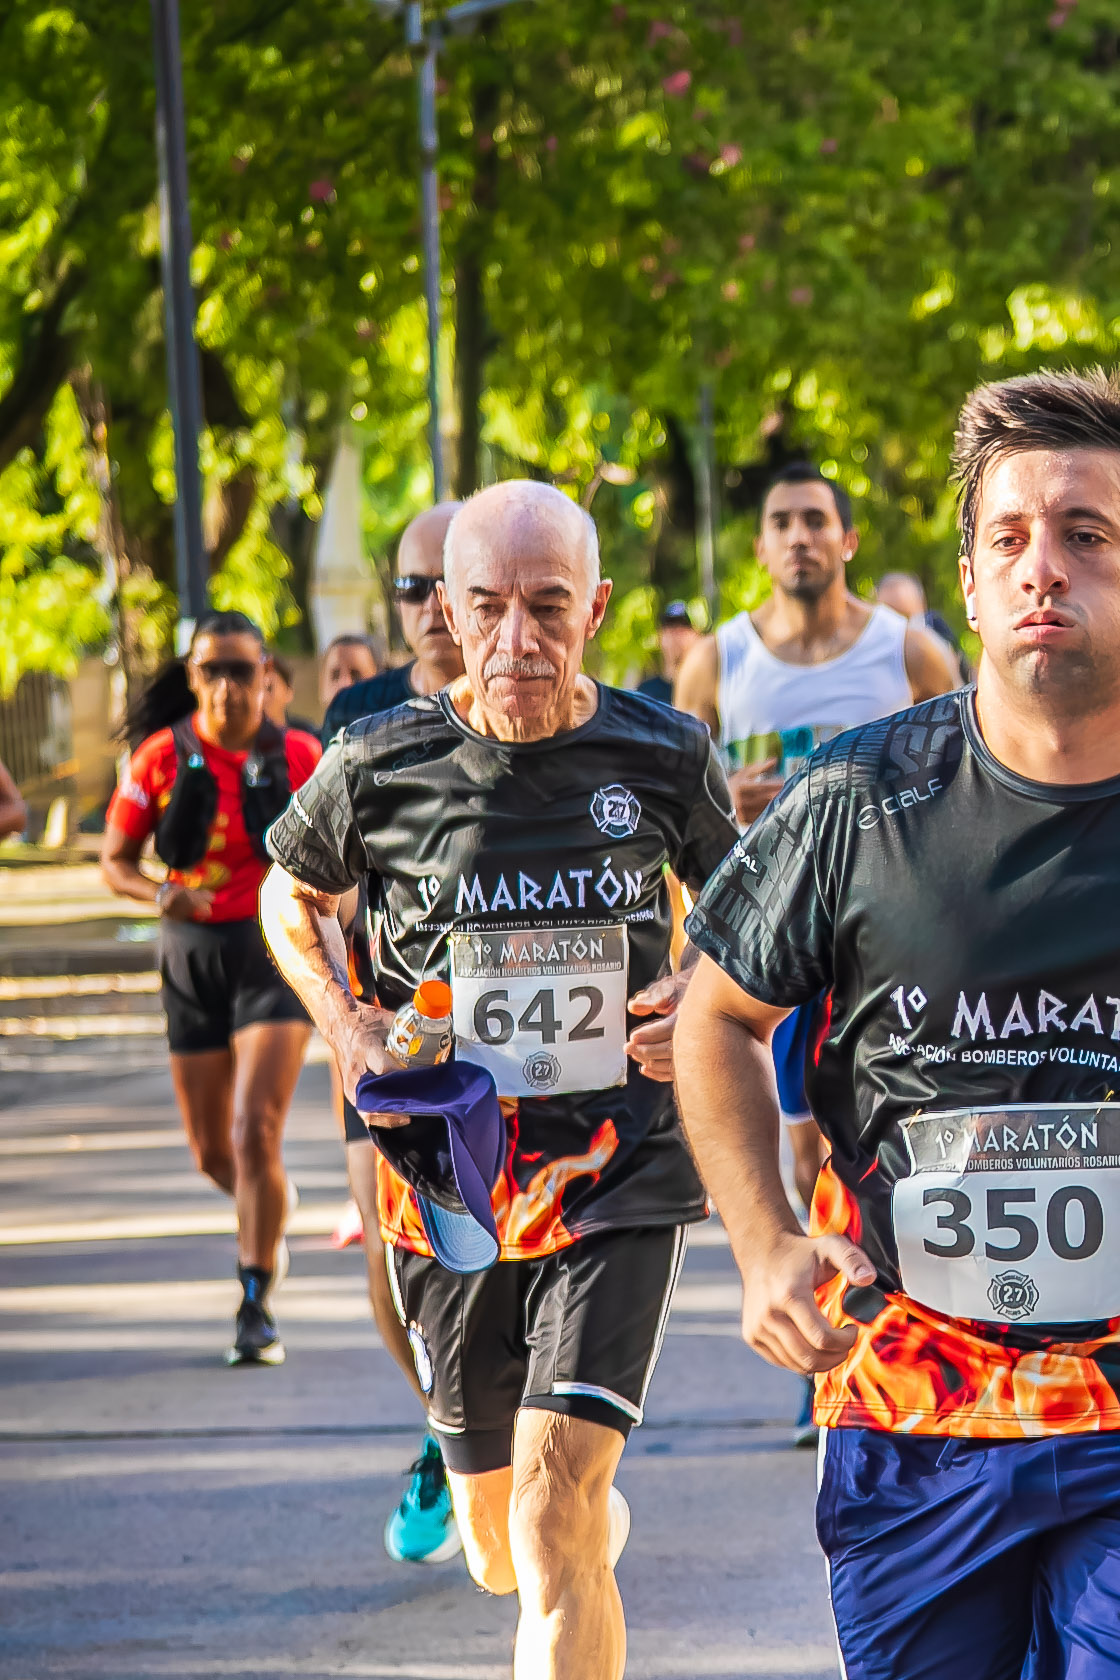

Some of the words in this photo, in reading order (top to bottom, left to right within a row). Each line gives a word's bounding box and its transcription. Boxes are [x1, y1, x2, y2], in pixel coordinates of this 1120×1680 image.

[608, 800, 626, 818] 27
[454, 856, 643, 914] MARATÓN
[499, 933, 604, 964] MARATÓN
[474, 986, 605, 1046] 642
[535, 1062, 550, 1077] 27
[961, 1049, 1047, 1068] BOMBEROS
[962, 1115, 1099, 1154] MARATÓN
[967, 1157, 1014, 1171] OMBEROS
[1016, 1155, 1081, 1169] VOLUNTARIOS
[922, 1184, 1105, 1263] 350
